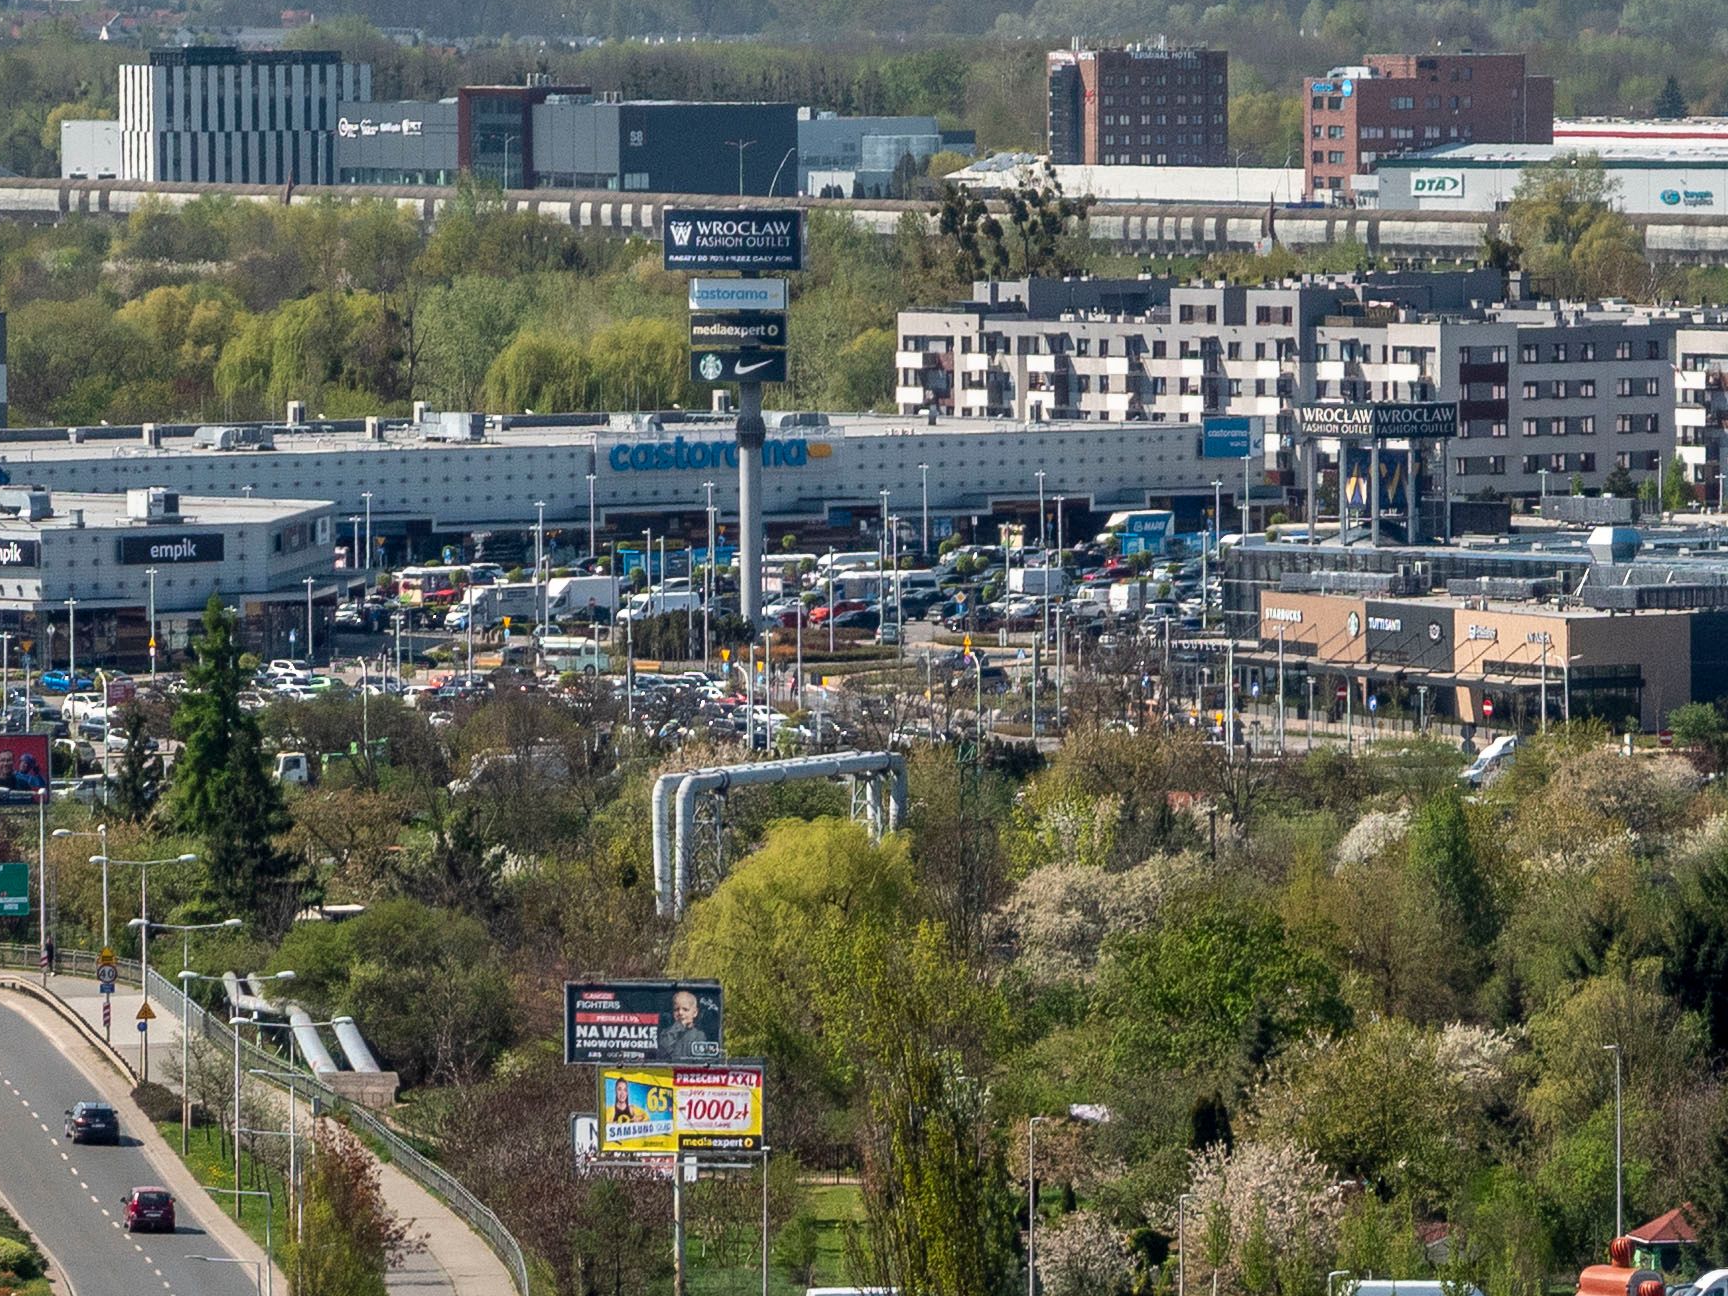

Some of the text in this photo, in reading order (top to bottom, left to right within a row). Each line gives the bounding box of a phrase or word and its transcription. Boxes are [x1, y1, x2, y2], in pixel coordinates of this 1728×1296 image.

[1414, 179, 1447, 192] DTA
[695, 236, 791, 247] FASHION OUTLET
[694, 288, 768, 300] castorama
[693, 324, 765, 338] mediaexpert
[1302, 423, 1373, 435] FASHION OUTLET
[1377, 423, 1455, 435] FASHION OUTLET
[150, 537, 197, 562] empik
[1265, 608, 1302, 622] STARBUCKS
[100, 968, 115, 979] 40
[576, 1000, 621, 1010] FIGHTERS
[576, 1025, 600, 1039] NA
[576, 1039, 659, 1049] Z NOWOTWOREM
[676, 1072, 754, 1086] PRZECENY XXL
[682, 1136, 743, 1149] mediaexpert
